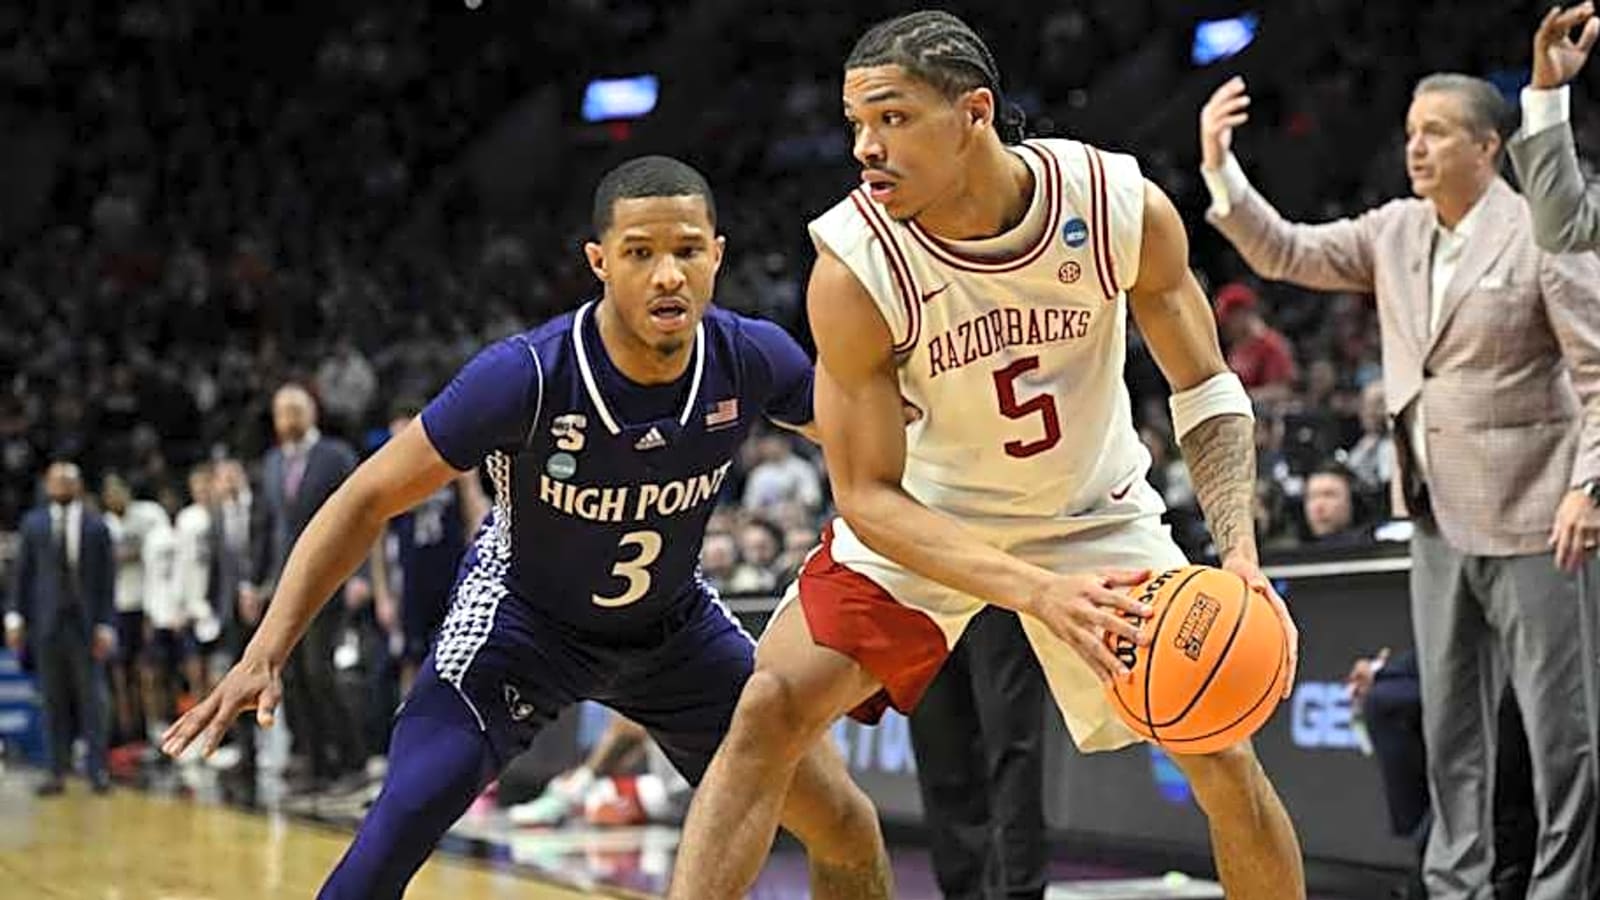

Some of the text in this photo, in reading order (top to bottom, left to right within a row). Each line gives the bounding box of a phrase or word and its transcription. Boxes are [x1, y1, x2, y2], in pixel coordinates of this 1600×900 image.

[928, 308, 1092, 378] RAZORBACKS
[993, 355, 1061, 458] 5
[540, 475, 628, 521] HIGH
[592, 530, 663, 608] 3
